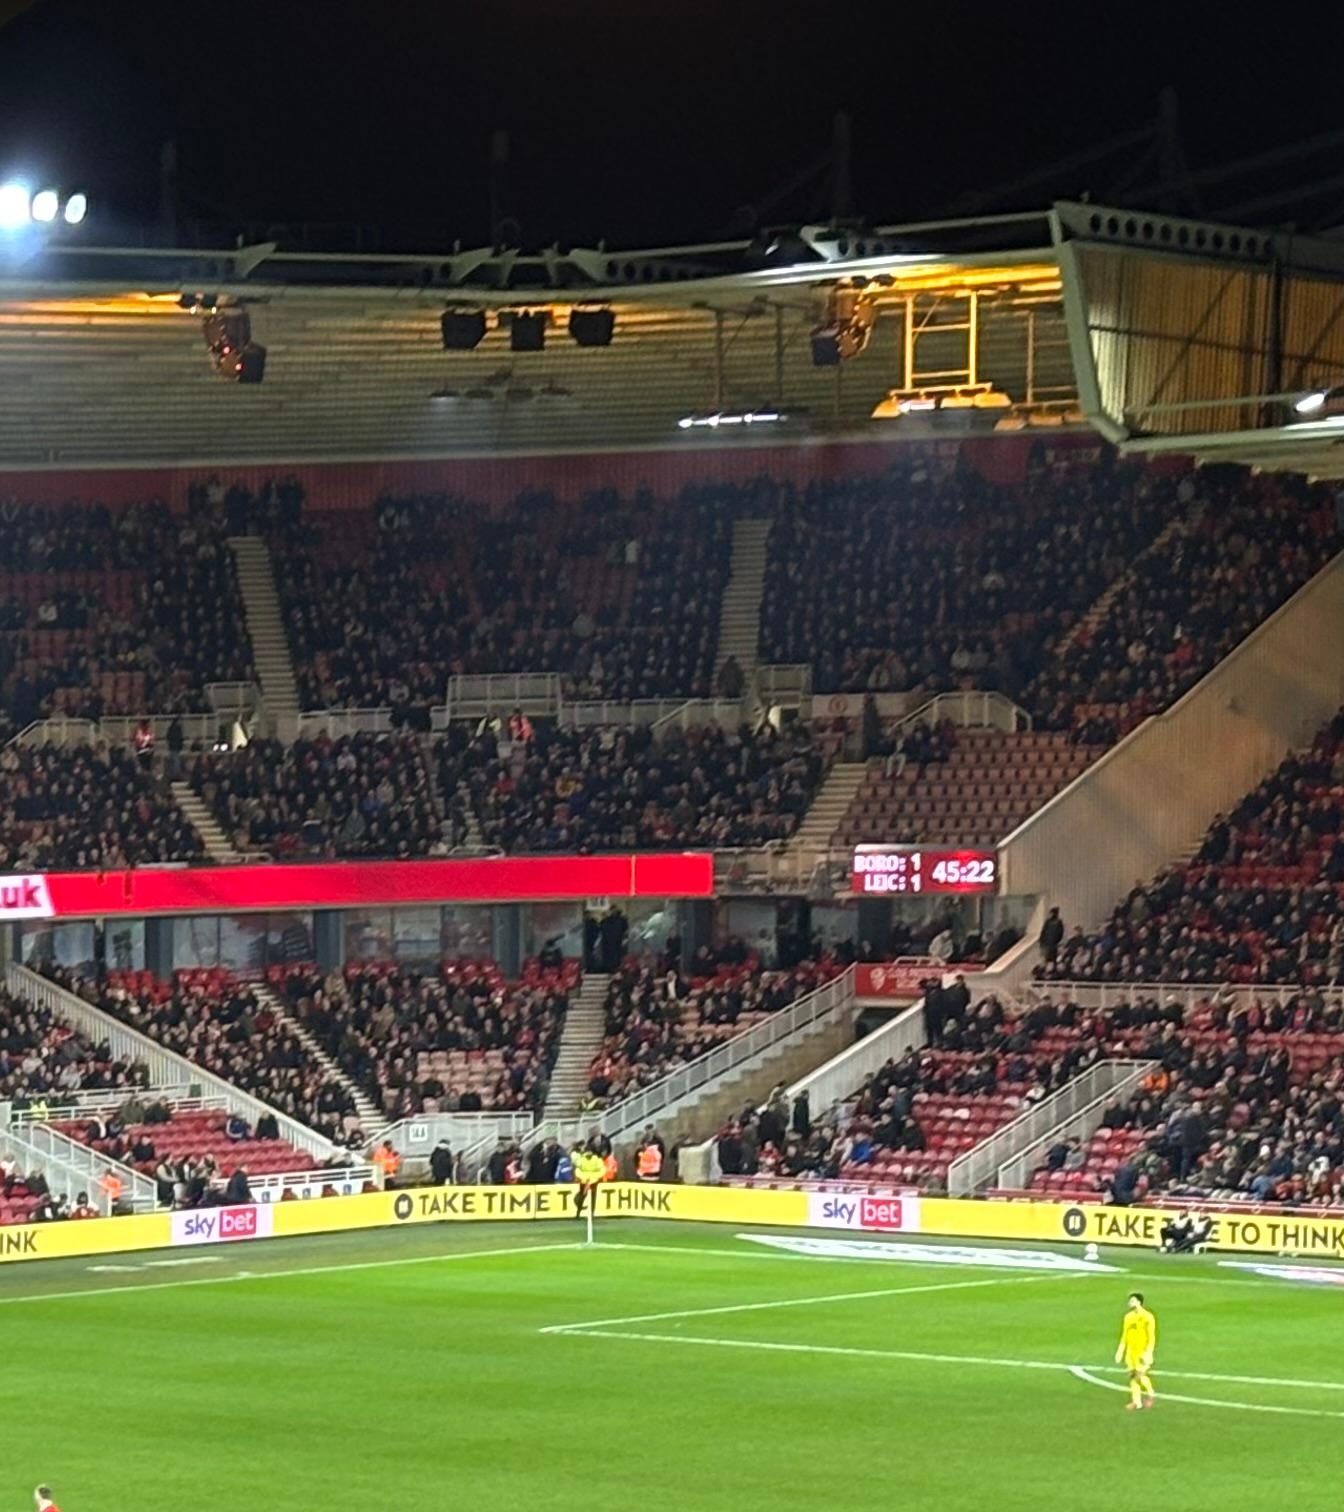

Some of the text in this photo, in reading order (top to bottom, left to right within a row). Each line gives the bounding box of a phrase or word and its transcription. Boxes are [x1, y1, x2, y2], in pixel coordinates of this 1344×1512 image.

[910, 853, 921, 871] 1
[932, 860, 994, 883] 45:22
[864, 873, 921, 892] LEIC: 1
[419, 1191, 476, 1215] TAKE
[483, 1191, 551, 1213] TIME
[602, 1188, 671, 1212] THINK
[823, 1198, 900, 1224] sky bet
[184, 1210, 255, 1239] sky bet
[1094, 1213, 1155, 1239] TAKE
[1227, 1222, 1261, 1245] TO
